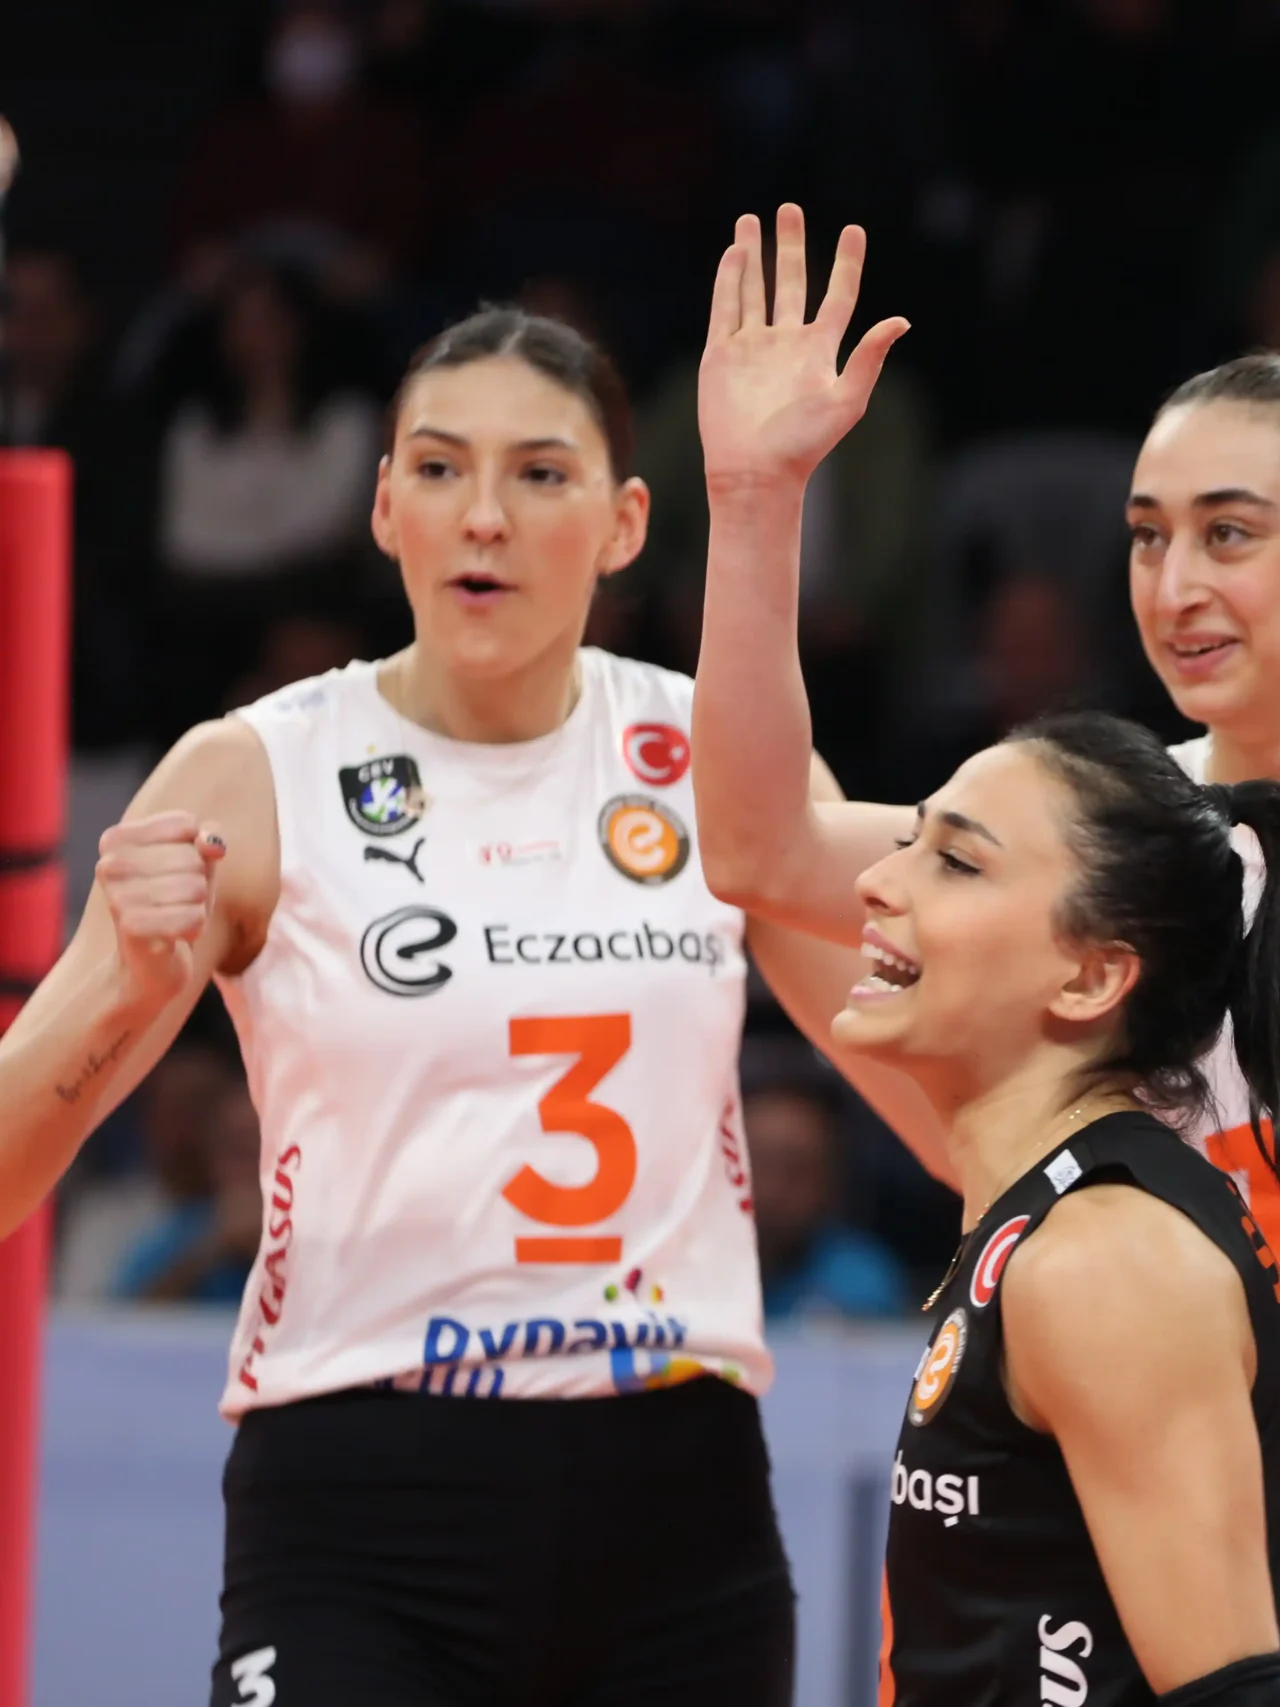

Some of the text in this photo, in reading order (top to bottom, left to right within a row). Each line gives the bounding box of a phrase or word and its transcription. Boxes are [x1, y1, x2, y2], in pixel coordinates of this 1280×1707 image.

[500, 1012, 638, 1228] 3
[230, 1644, 277, 1707] 3
[1037, 1612, 1094, 1707] US
